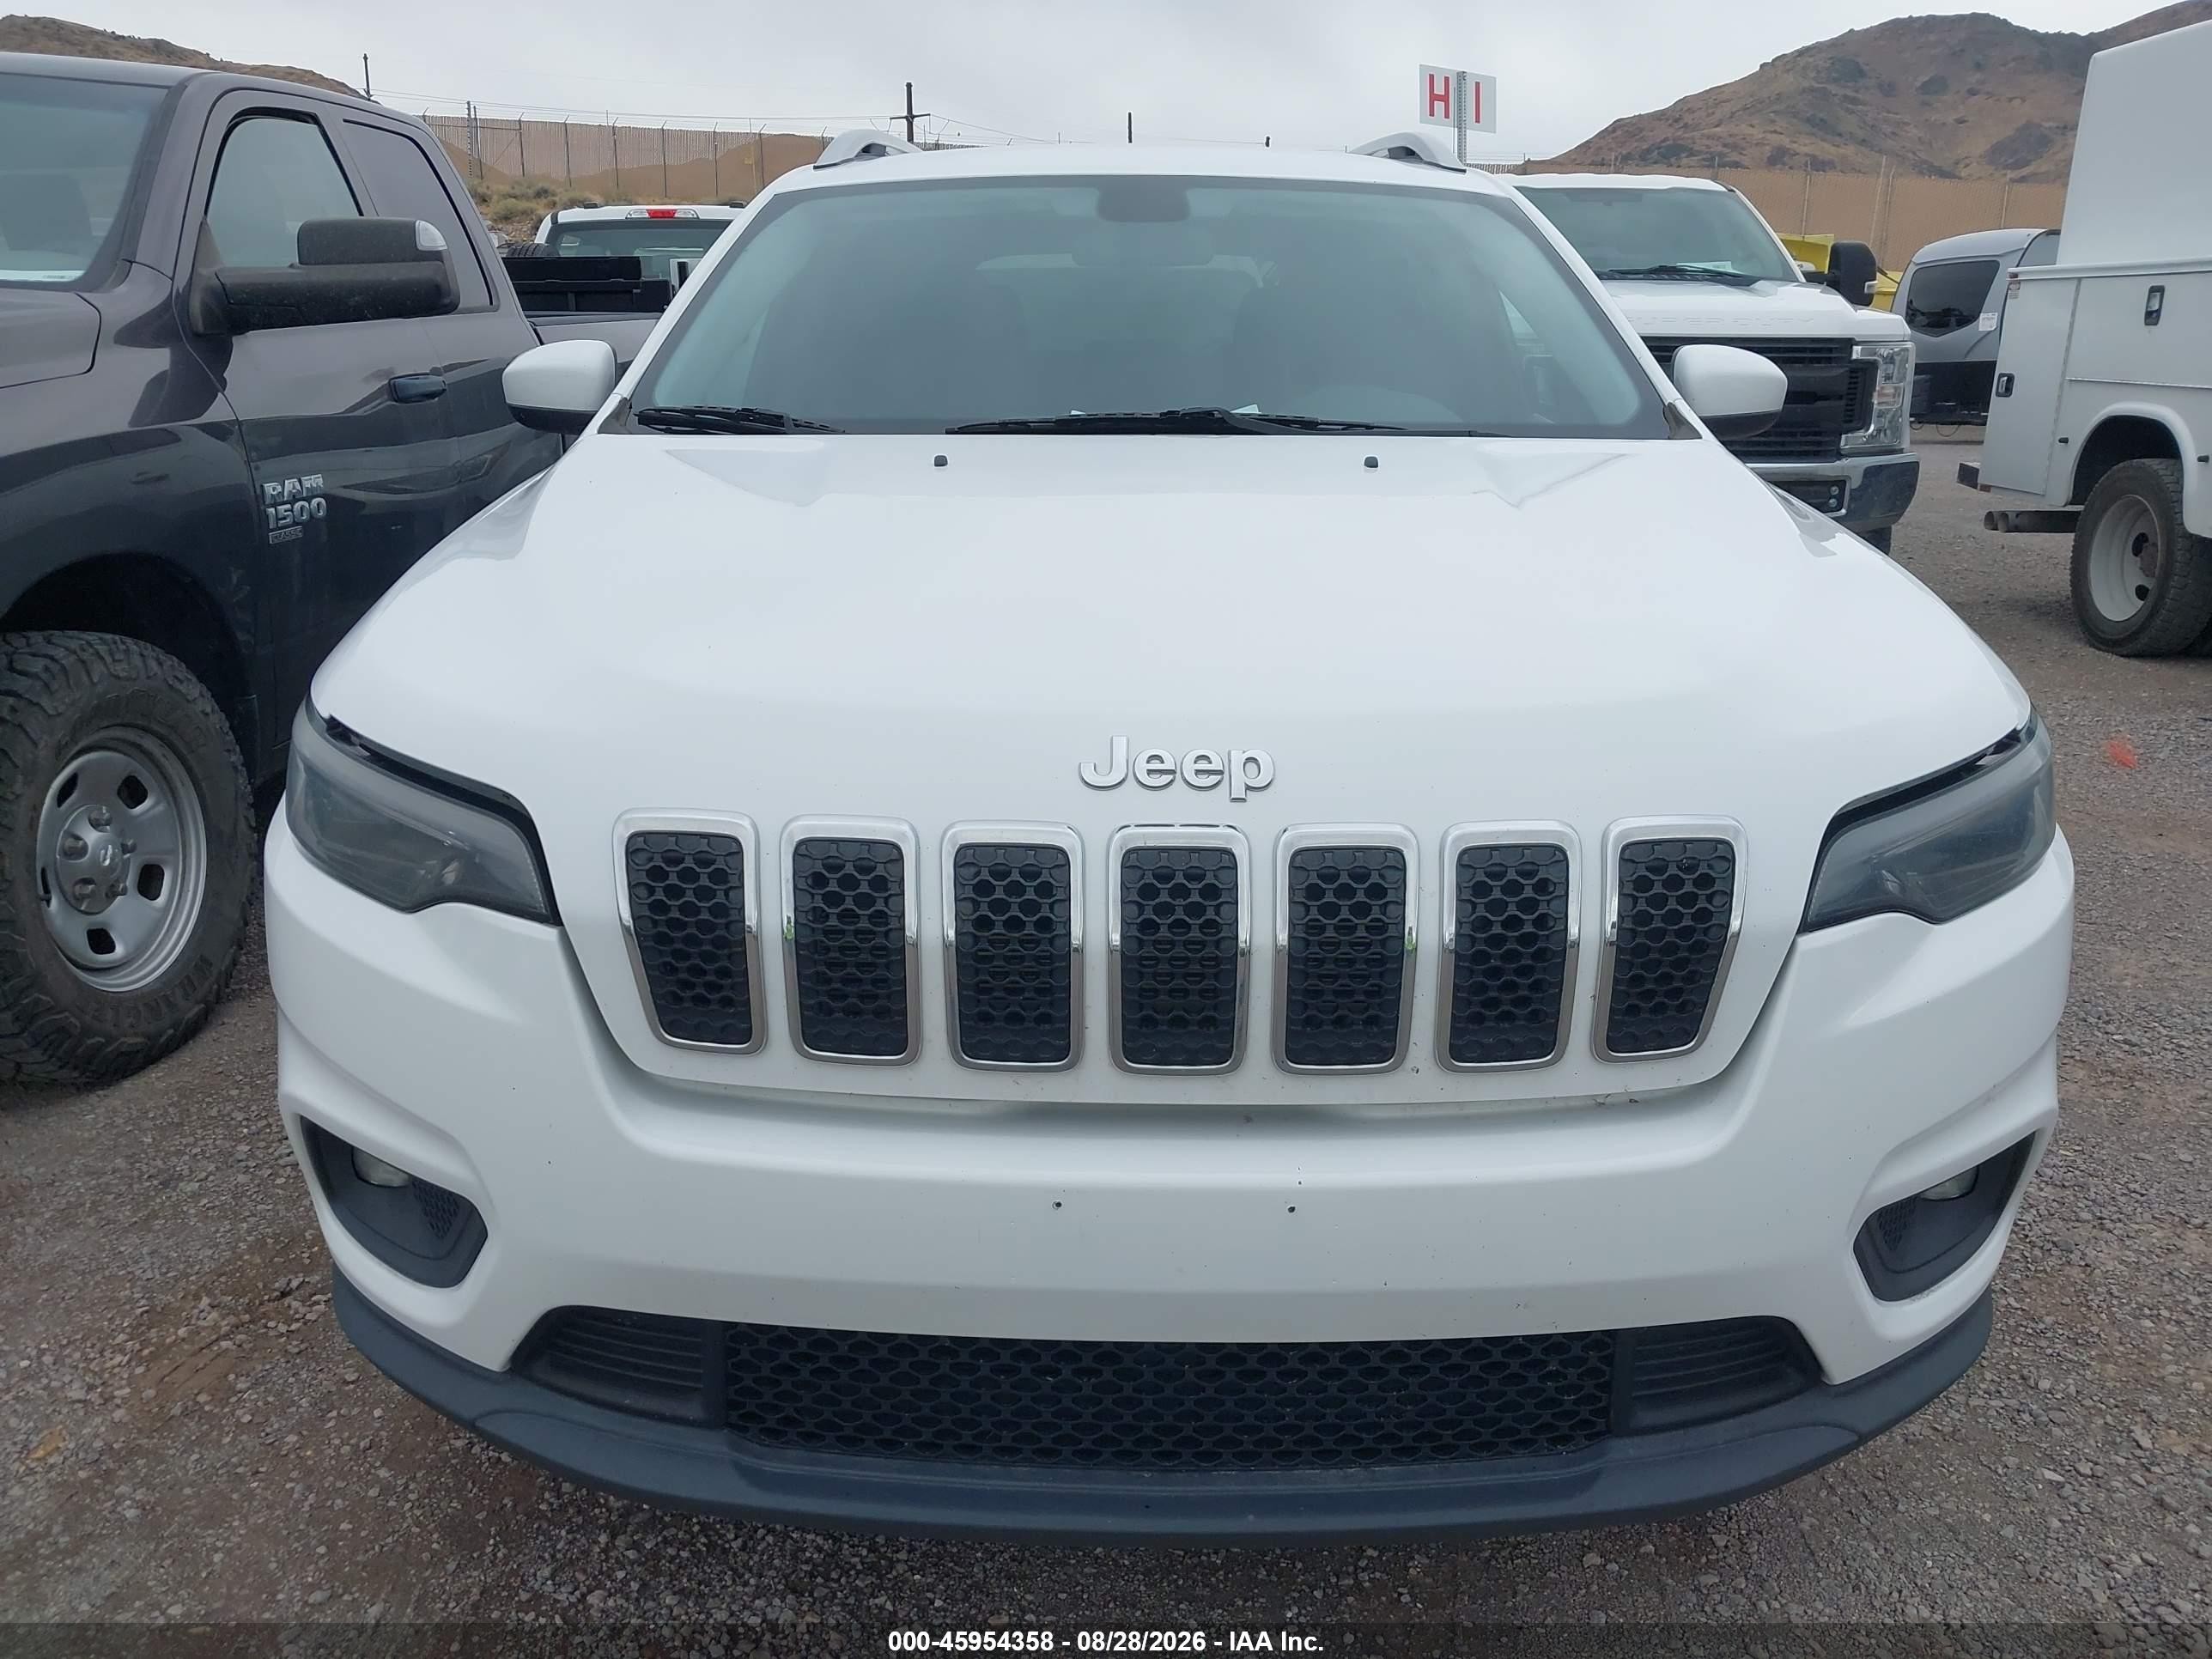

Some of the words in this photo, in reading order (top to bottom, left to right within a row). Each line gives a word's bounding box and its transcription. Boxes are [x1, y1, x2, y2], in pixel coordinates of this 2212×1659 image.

[1429, 73, 1449, 119] H
[262, 473, 323, 505] RAM
[265, 496, 326, 530] 1500
[1079, 734, 1274, 803] Jeep
